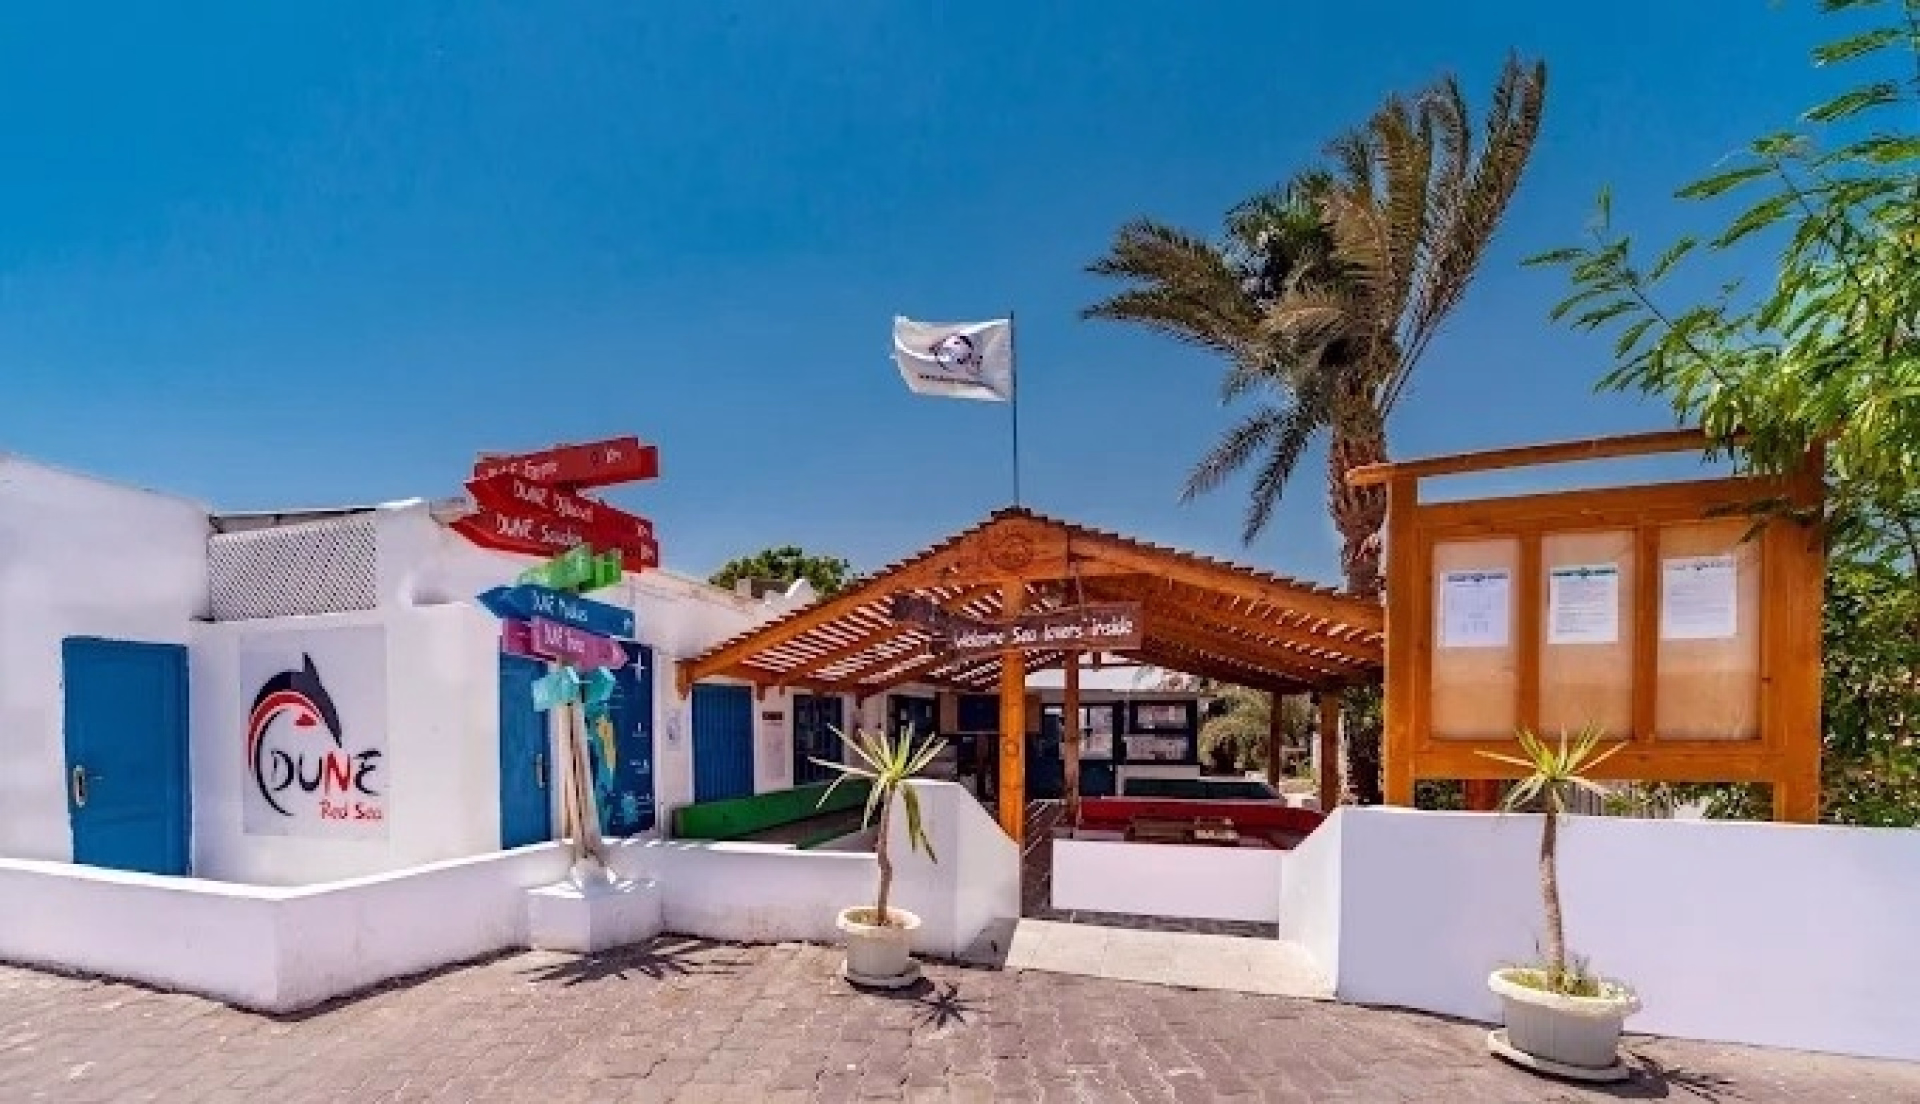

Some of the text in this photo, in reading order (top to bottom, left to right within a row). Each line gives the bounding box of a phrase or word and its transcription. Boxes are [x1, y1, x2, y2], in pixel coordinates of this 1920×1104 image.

[497, 514, 534, 540] DUNE
[1012, 626, 1037, 643] Sea
[270, 748, 382, 797] DUNE
[319, 799, 382, 819] Red Sea
